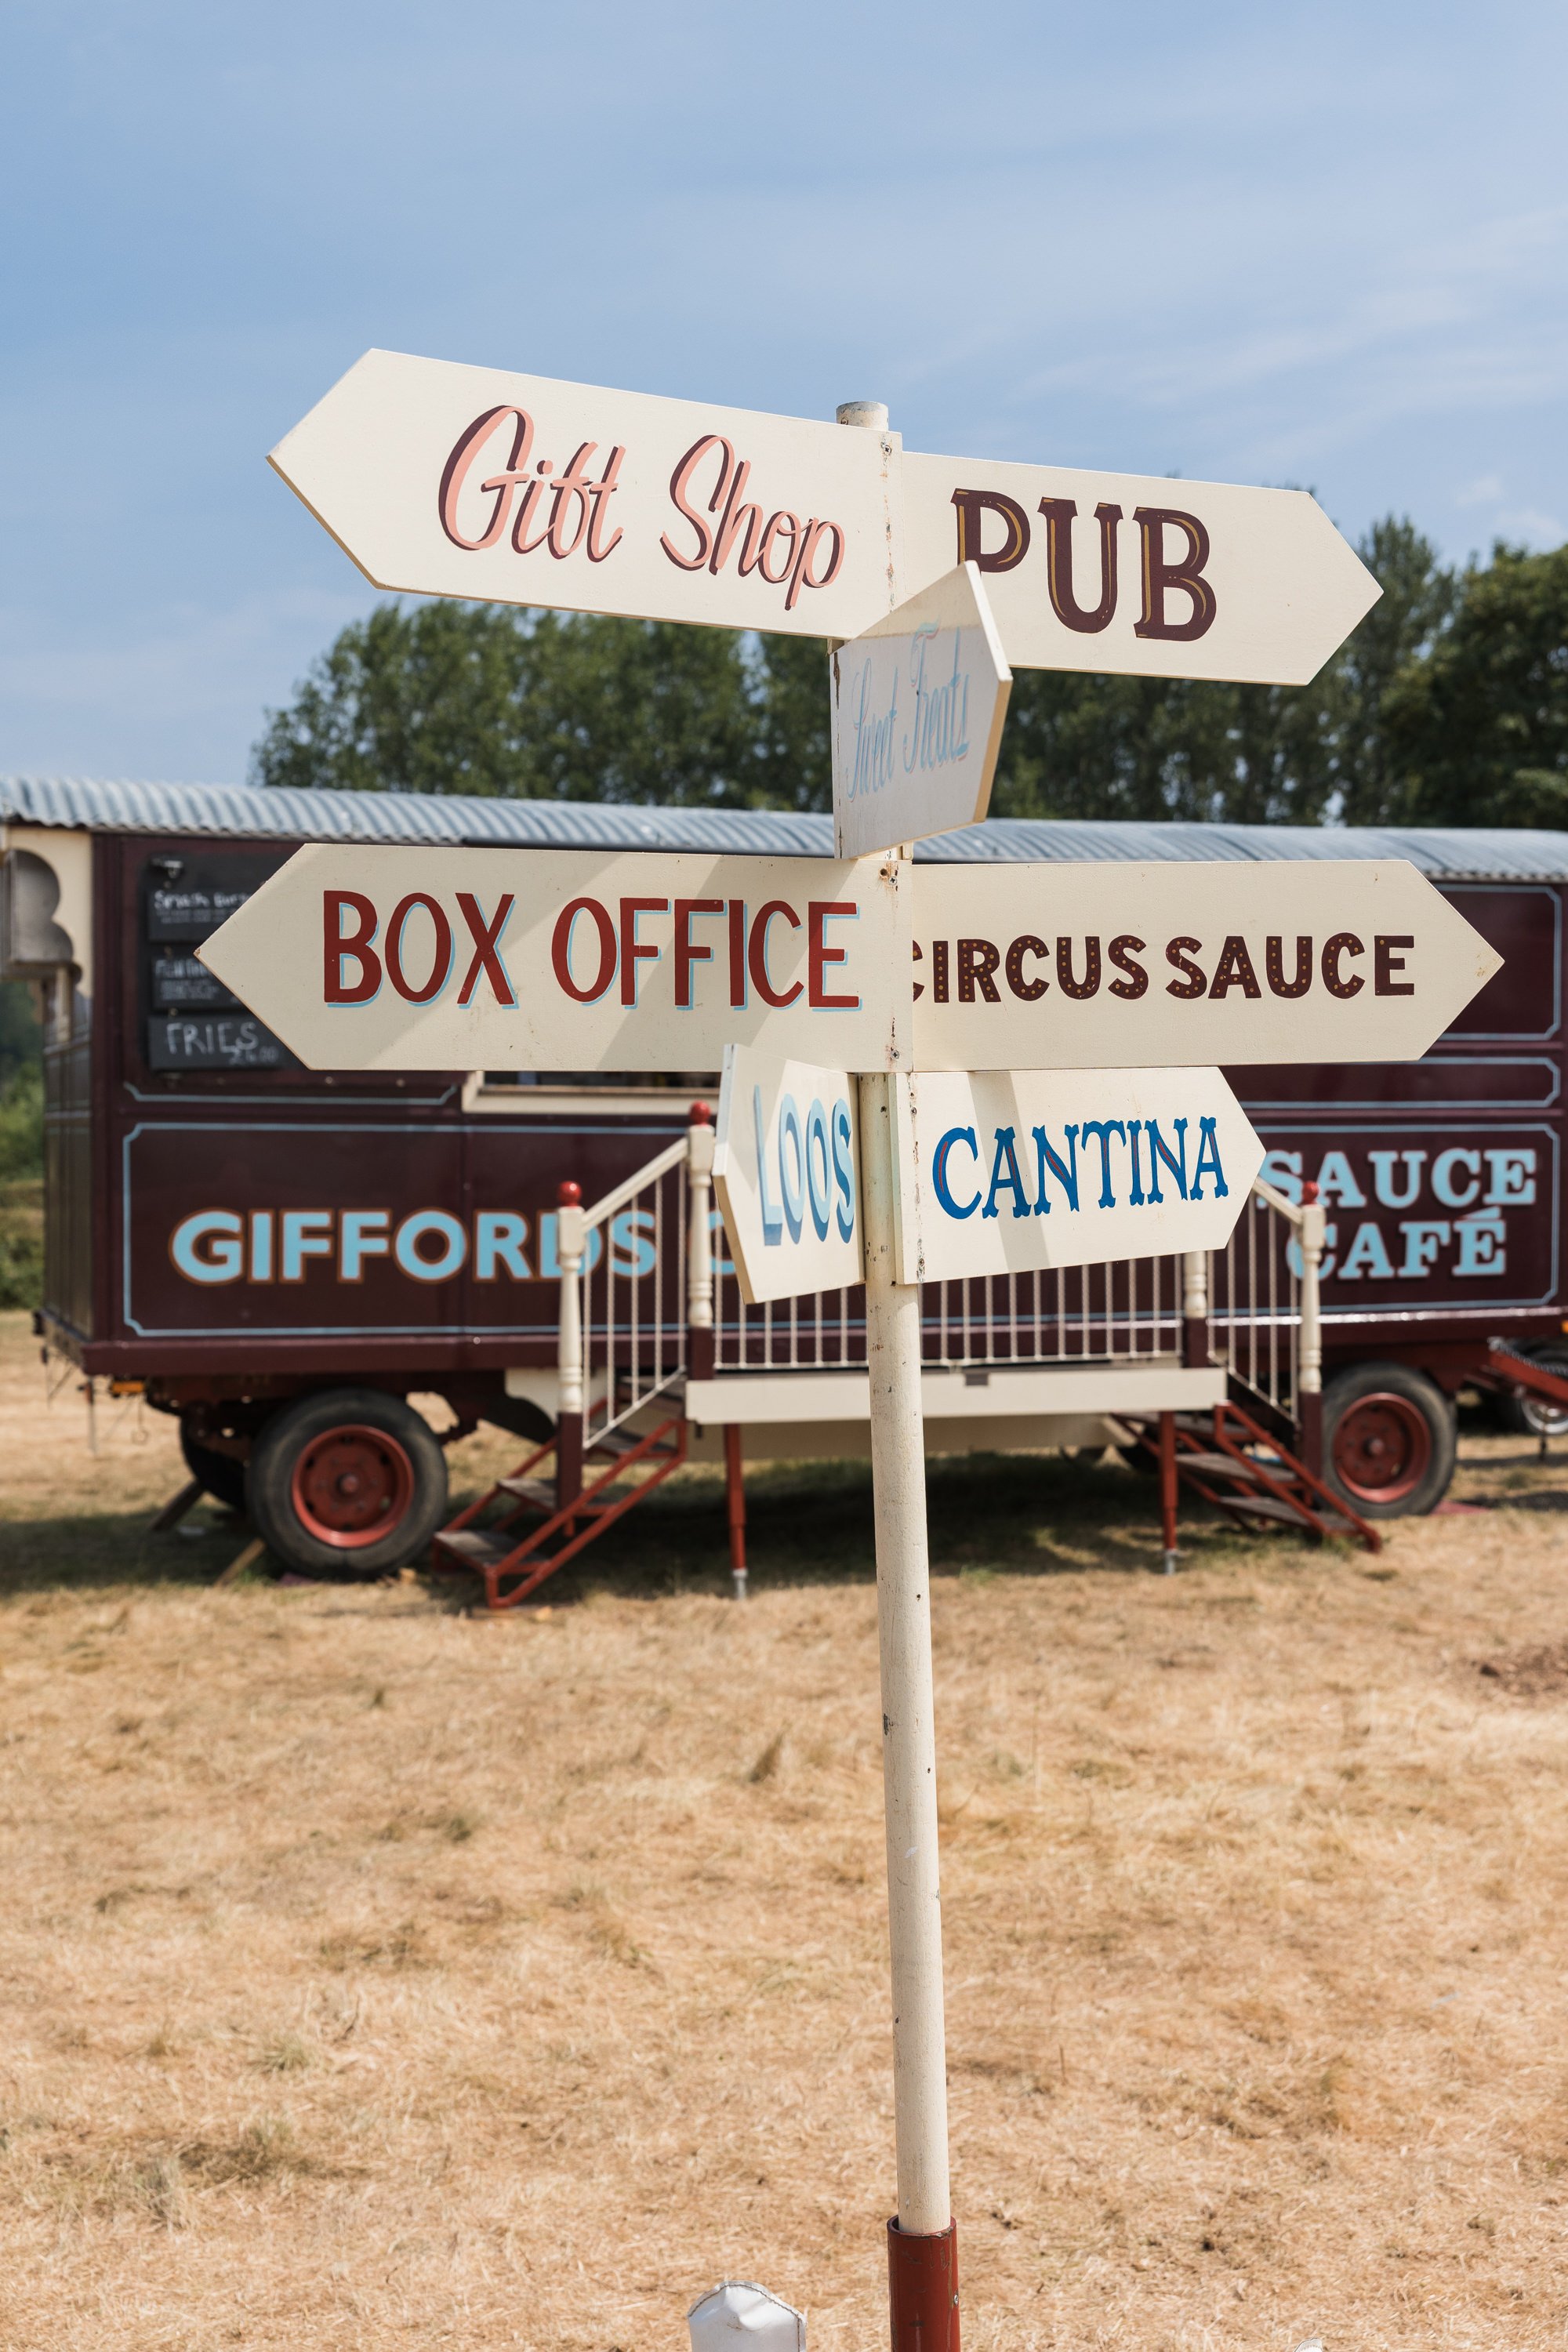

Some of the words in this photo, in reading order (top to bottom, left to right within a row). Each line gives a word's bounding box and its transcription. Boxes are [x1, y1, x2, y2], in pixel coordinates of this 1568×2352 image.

[438, 405, 626, 562] Gift
[659, 434, 845, 611] Shop
[950, 488, 1218, 642] PUB
[846, 657, 898, 802] Sweet
[902, 615, 971, 774] Treats
[323, 890, 520, 1009] BOX
[551, 897, 862, 1012] OFFICE
[1165, 932, 1415, 1000] SAUCE
[166, 1021, 260, 1056] FRIES
[753, 1084, 856, 1247] LOOS
[933, 1116, 1229, 1220] CANTINA
[1255, 1148, 1537, 1210] SAUCE
[167, 1206, 659, 1287] GIFFORDS
[1285, 1206, 1508, 1282] CAFÉ
